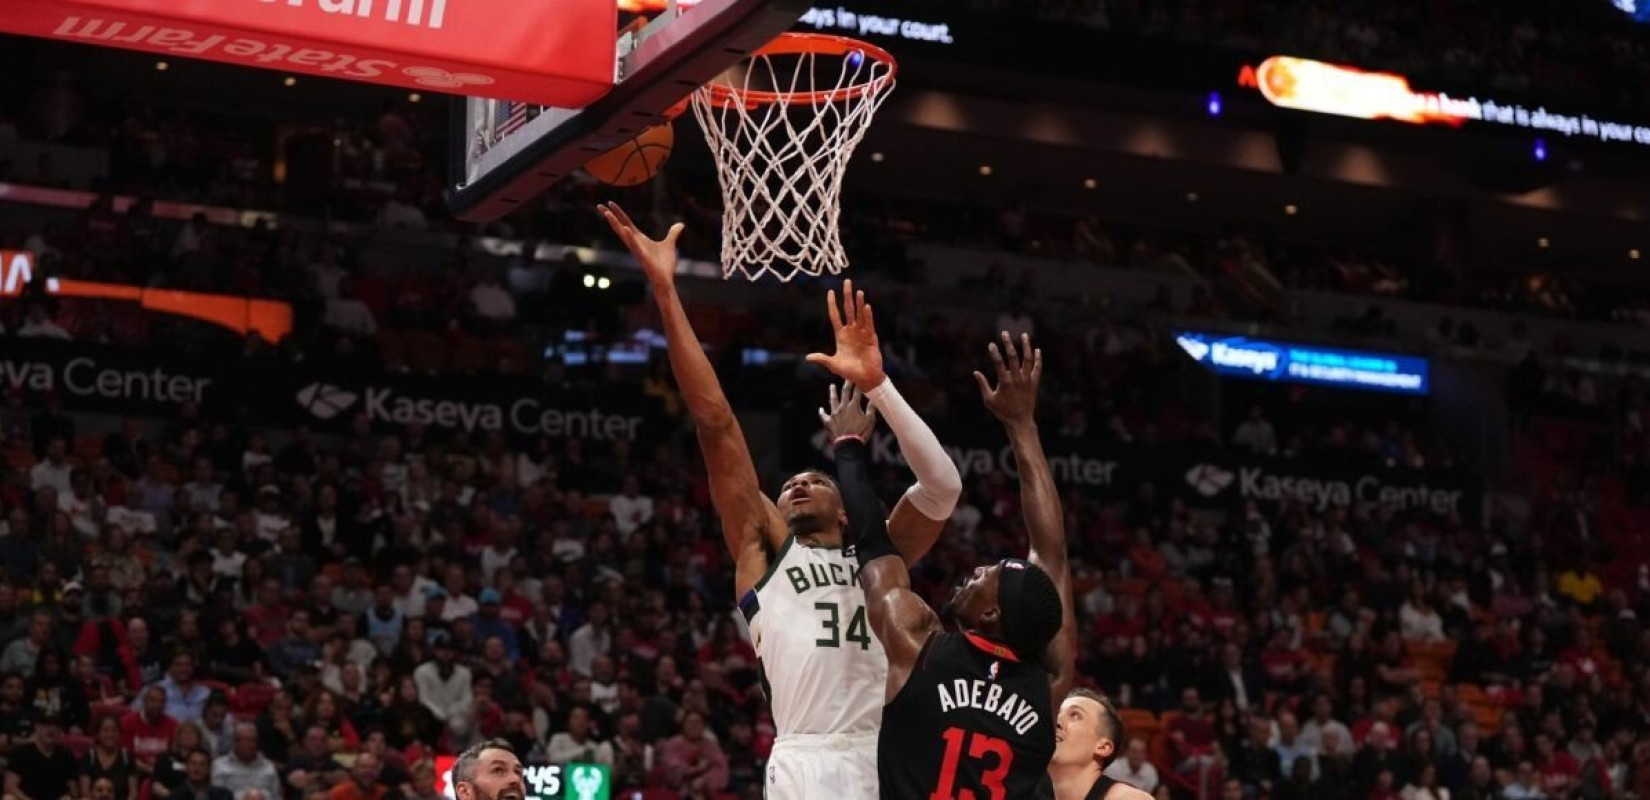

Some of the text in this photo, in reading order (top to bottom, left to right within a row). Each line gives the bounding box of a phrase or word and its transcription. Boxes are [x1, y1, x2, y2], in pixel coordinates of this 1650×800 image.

[53, 16, 398, 77] State Farm
[837, 7, 857, 28] in
[858, 14, 899, 35] your
[901, 20, 953, 44] court.
[1483, 99, 1514, 124] that
[1515, 104, 1530, 127] is
[1531, 106, 1580, 136] always
[1581, 114, 1599, 136] in
[1599, 121, 1632, 142] your
[63, 357, 212, 403] Center
[364, 386, 643, 440] Kaseya Center
[999, 443, 1118, 484] Cnter
[1239, 467, 1463, 515] Kaseya Center
[784, 562, 864, 594] BUCK
[814, 602, 871, 650] 34
[937, 678, 1039, 735] ADEBAYO
[929, 726, 1014, 800] 13
